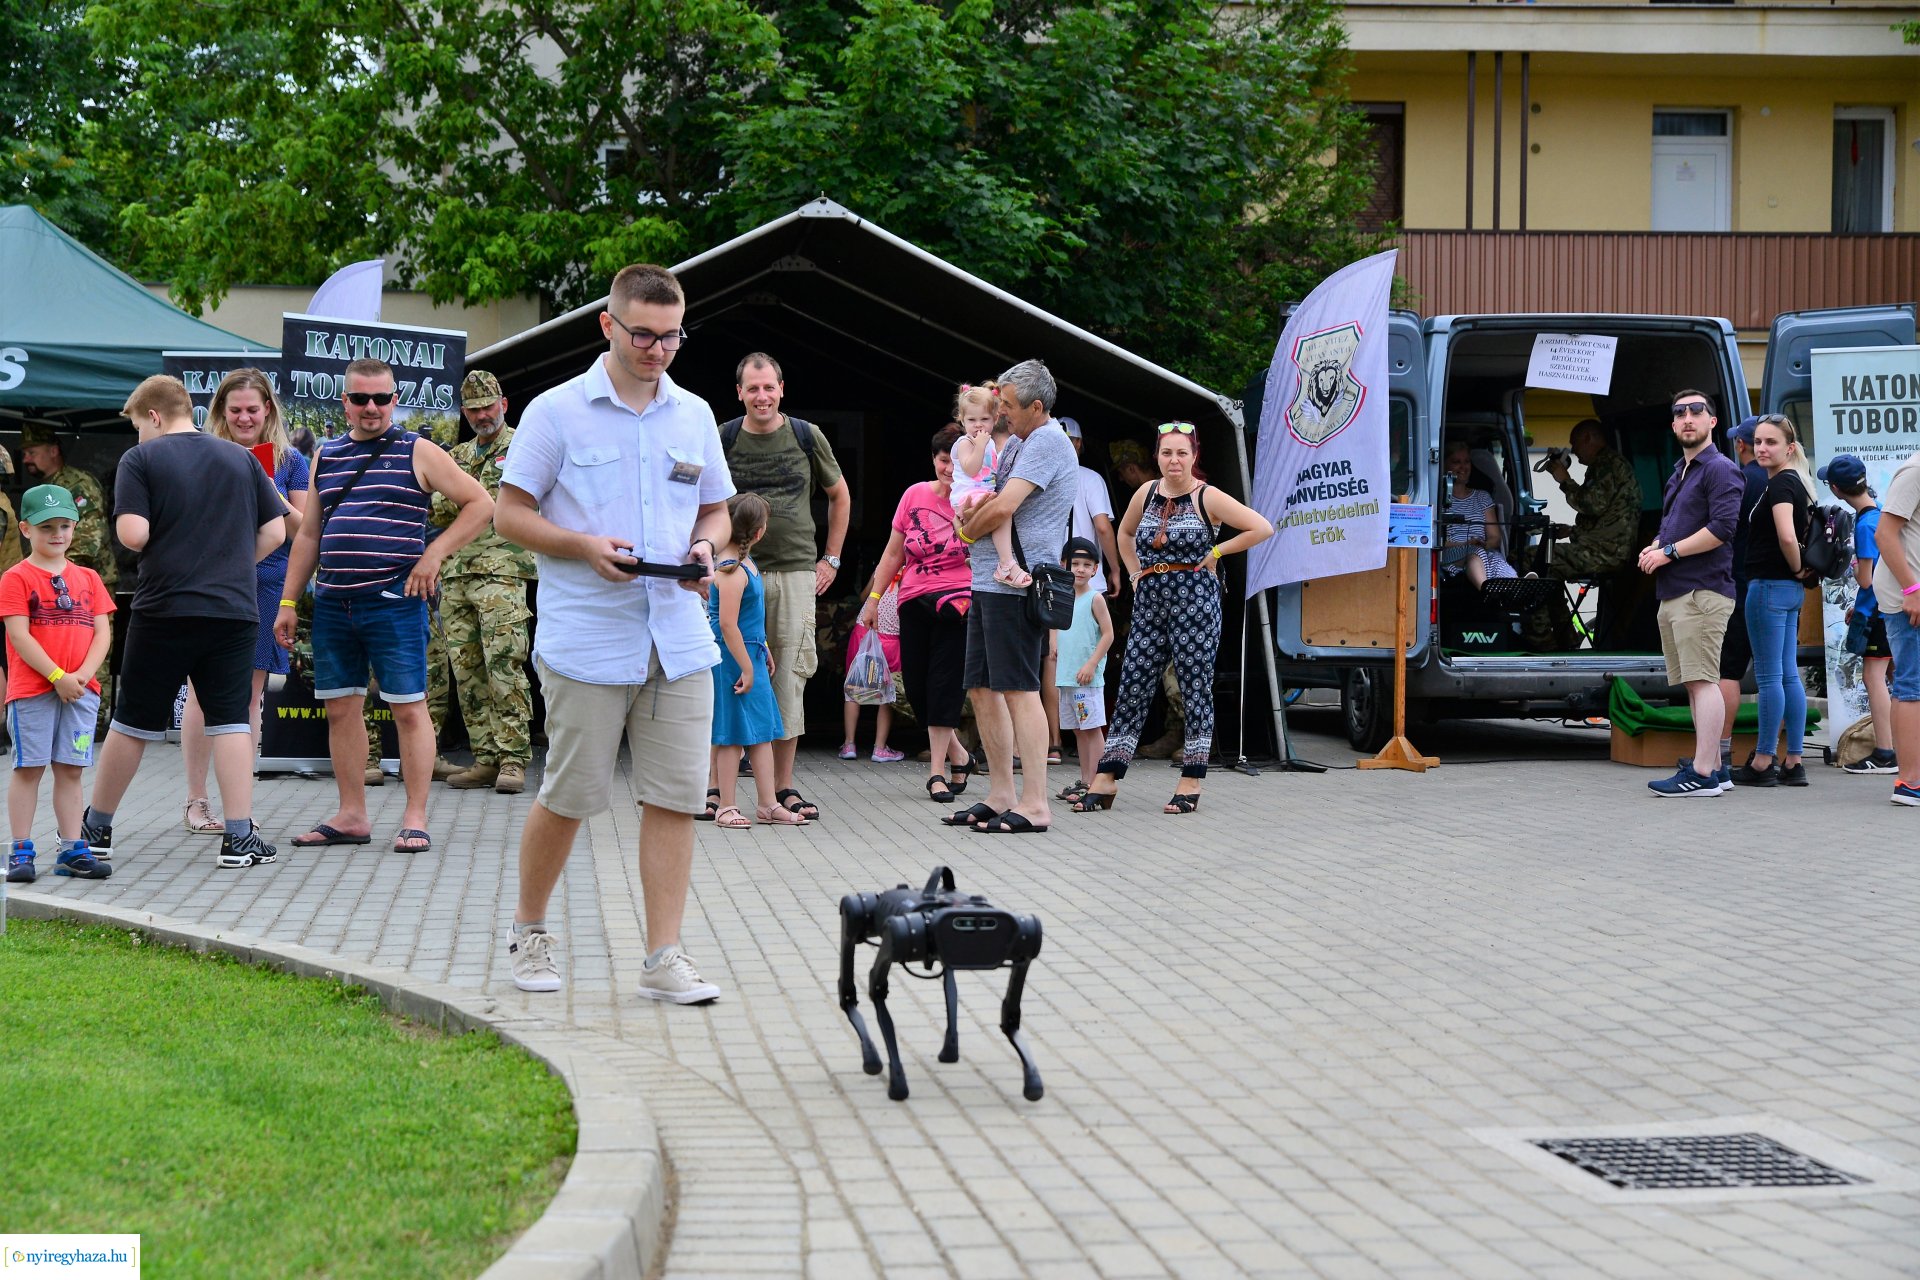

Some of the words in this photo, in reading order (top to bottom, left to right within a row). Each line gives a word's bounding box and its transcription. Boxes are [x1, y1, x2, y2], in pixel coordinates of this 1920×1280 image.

[1544, 338, 1592, 348] SZIMULÁTORT
[1592, 342, 1611, 350] CSAK
[305, 331, 446, 370] KATONAI
[1558, 346, 1577, 354] ÉVES
[1577, 348, 1597, 357] KORT
[1551, 355, 1591, 365] BETÖLTÖTT
[0, 347, 29, 391] S
[1550, 363, 1590, 374] SZEMÉLYEK
[1538, 370, 1600, 383] HASZNÁLHATJÁK!
[1832, 408, 1920, 435] TOBOR
[1859, 444, 1884, 452] MAGYAR
[1884, 443, 1920, 451] ÁLLAMPOLG
[1863, 453, 1889, 462] VÉDELME
[1896, 452, 1912, 460] NEKÜ
[1310, 526, 1347, 546] Erők
[34, 618, 79, 626] LONDON
